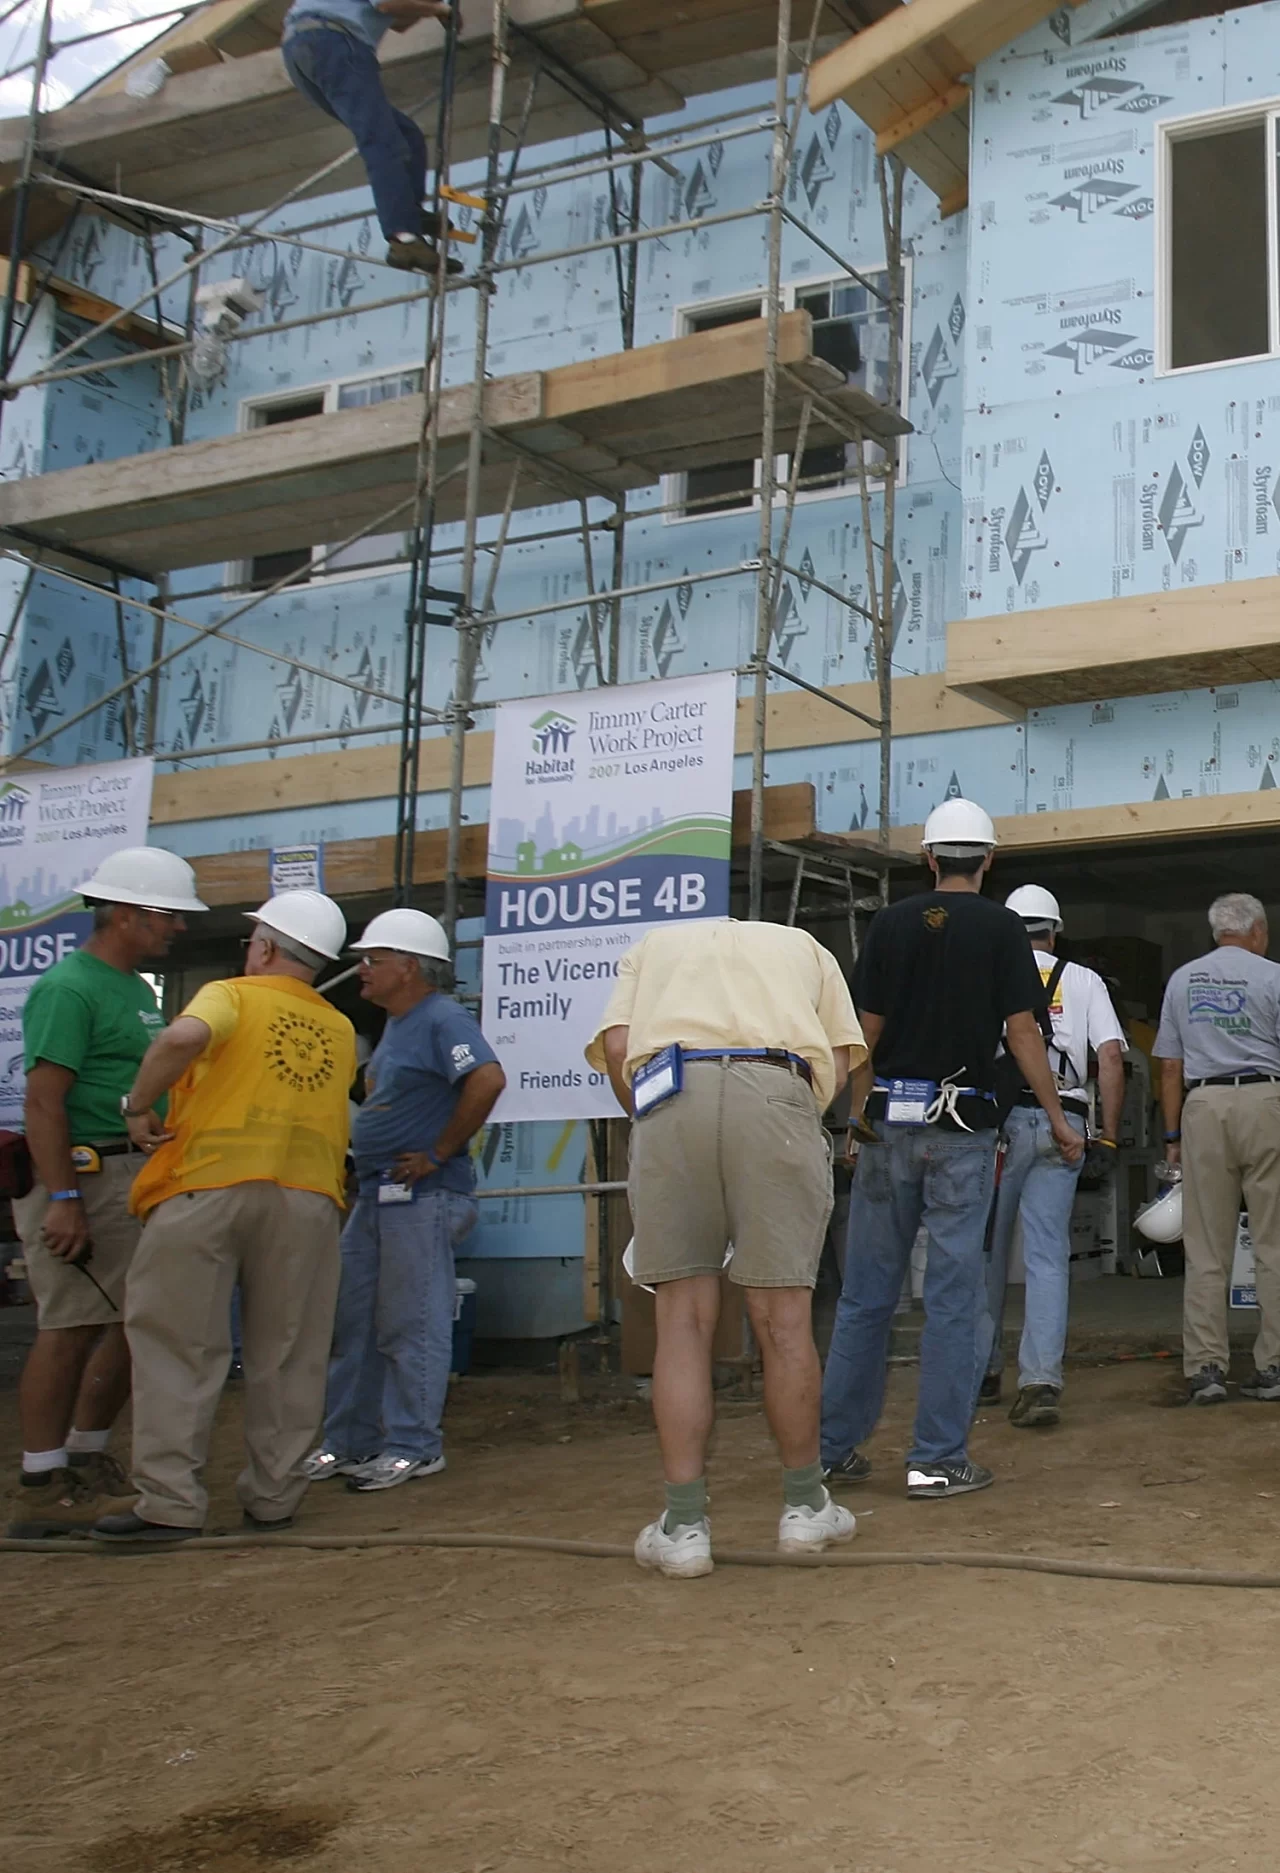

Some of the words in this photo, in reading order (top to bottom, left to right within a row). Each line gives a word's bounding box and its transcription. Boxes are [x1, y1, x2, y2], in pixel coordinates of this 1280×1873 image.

[1066, 57, 1127, 79] Styrofoam
[1064, 158, 1125, 181] Styrofoam
[1060, 308, 1122, 331] Styrofoam
[1254, 465, 1272, 535] Styrofoam
[1139, 483, 1158, 551] Styrofoam
[988, 506, 1006, 574] Styrofoam
[909, 572, 922, 631] Styrofoam
[558, 628, 572, 684] Styrofoam
[639, 615, 654, 673] Styrofoam
[372, 655, 387, 711] Strofoam
[588, 710, 647, 733] Jimmy
[649, 700, 708, 723] Carter
[589, 733, 639, 756] Work
[643, 724, 704, 752] Project
[525, 757, 576, 776] Habitat
[537, 773, 575, 784] Humanity
[588, 763, 621, 780] 2007
[624, 761, 648, 776] Los
[649, 754, 704, 773] Angeles
[88, 776, 132, 795] Carter
[39, 802, 77, 822] Work
[80, 797, 127, 818] Project
[62, 828, 81, 841] Los
[81, 823, 128, 839] Angeles
[499, 877, 643, 929] HOUSE
[653, 872, 707, 914] 4B
[0, 932, 77, 974] USE
[498, 941, 523, 955] built
[524, 940, 536, 953] in
[537, 936, 603, 954] partnership
[605, 932, 632, 947] with
[498, 962, 540, 986] The
[497, 992, 573, 1021] Family
[495, 1032, 517, 1045] and
[520, 1070, 583, 1090] Friends
